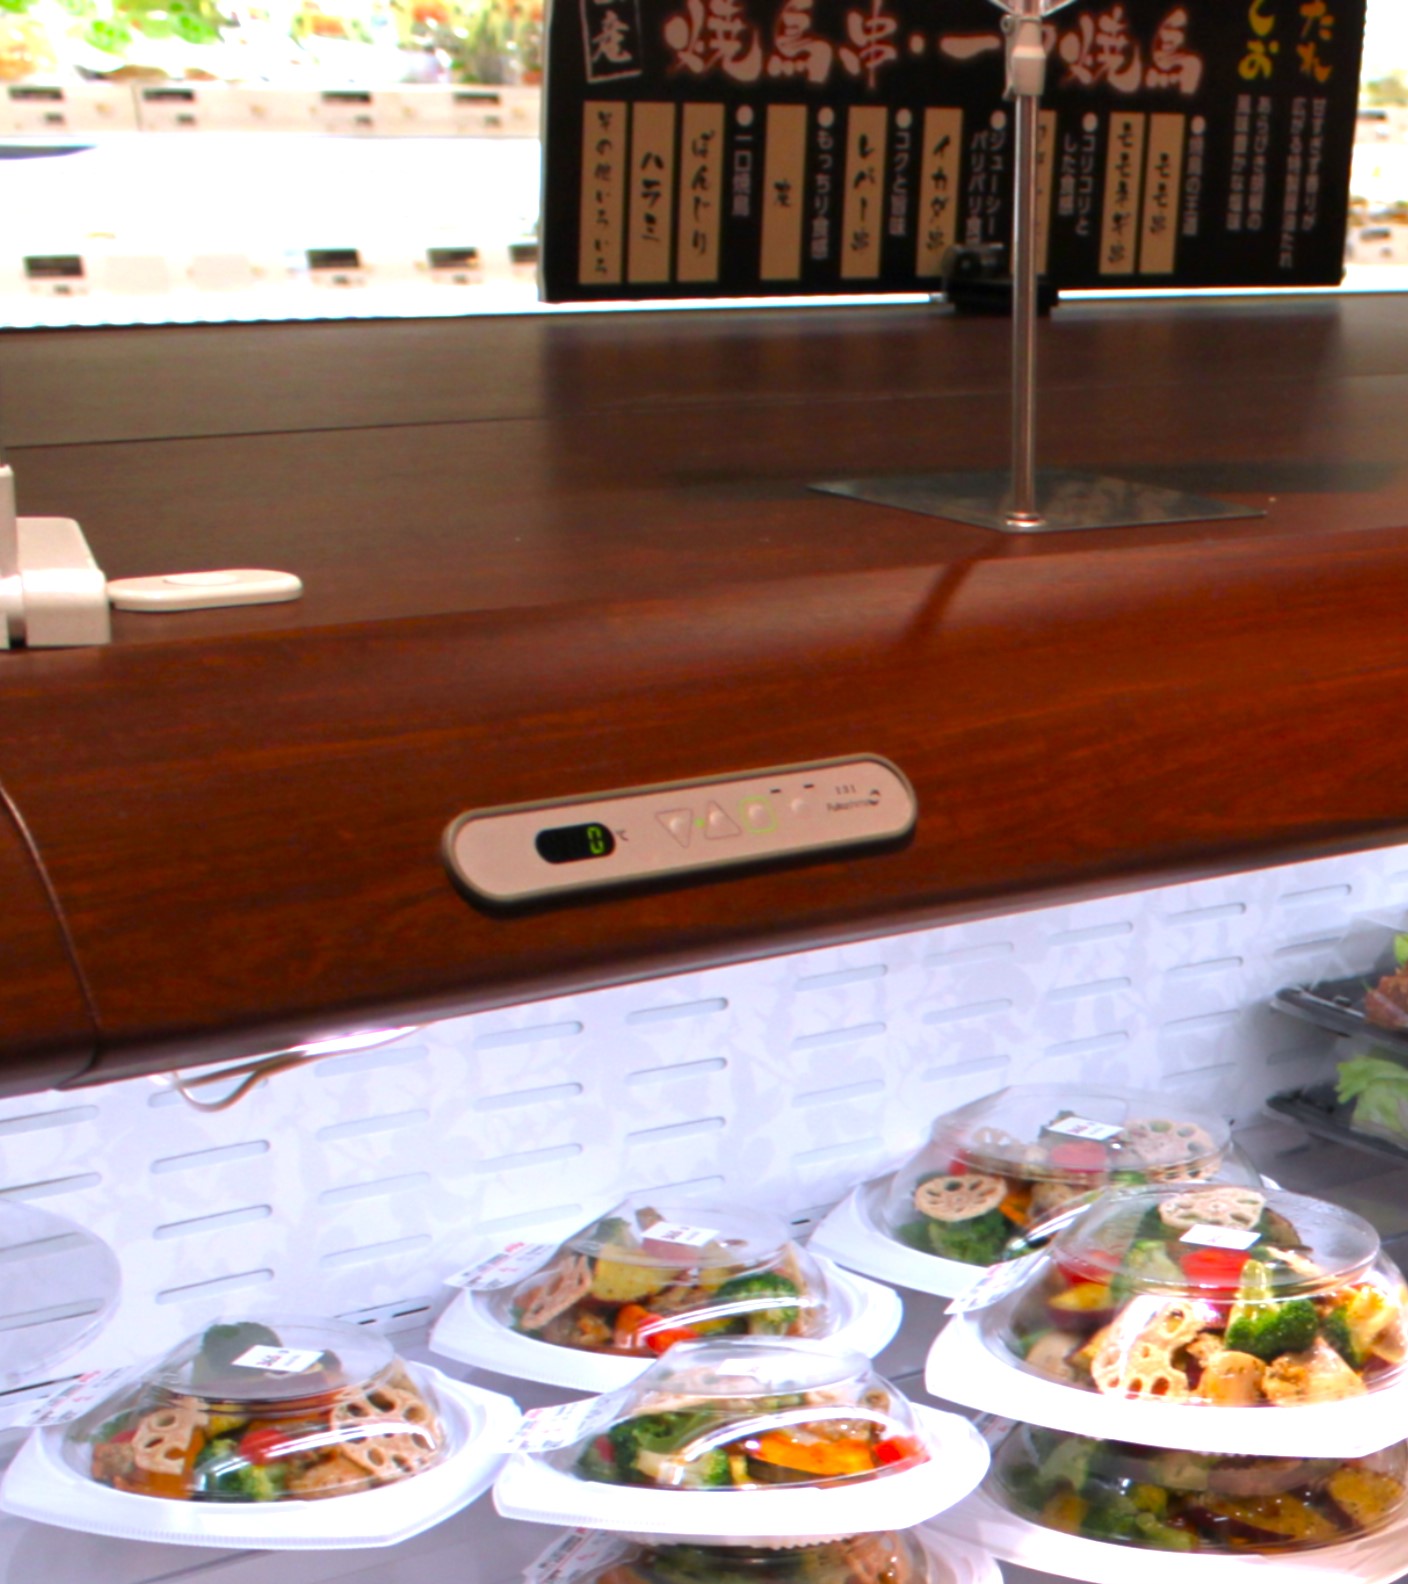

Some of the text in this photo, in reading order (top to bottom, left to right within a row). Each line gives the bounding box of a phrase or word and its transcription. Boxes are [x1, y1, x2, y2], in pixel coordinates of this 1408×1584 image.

[641, 151, 665, 243] ハラミ
[691, 130, 715, 256] ぼんじり
